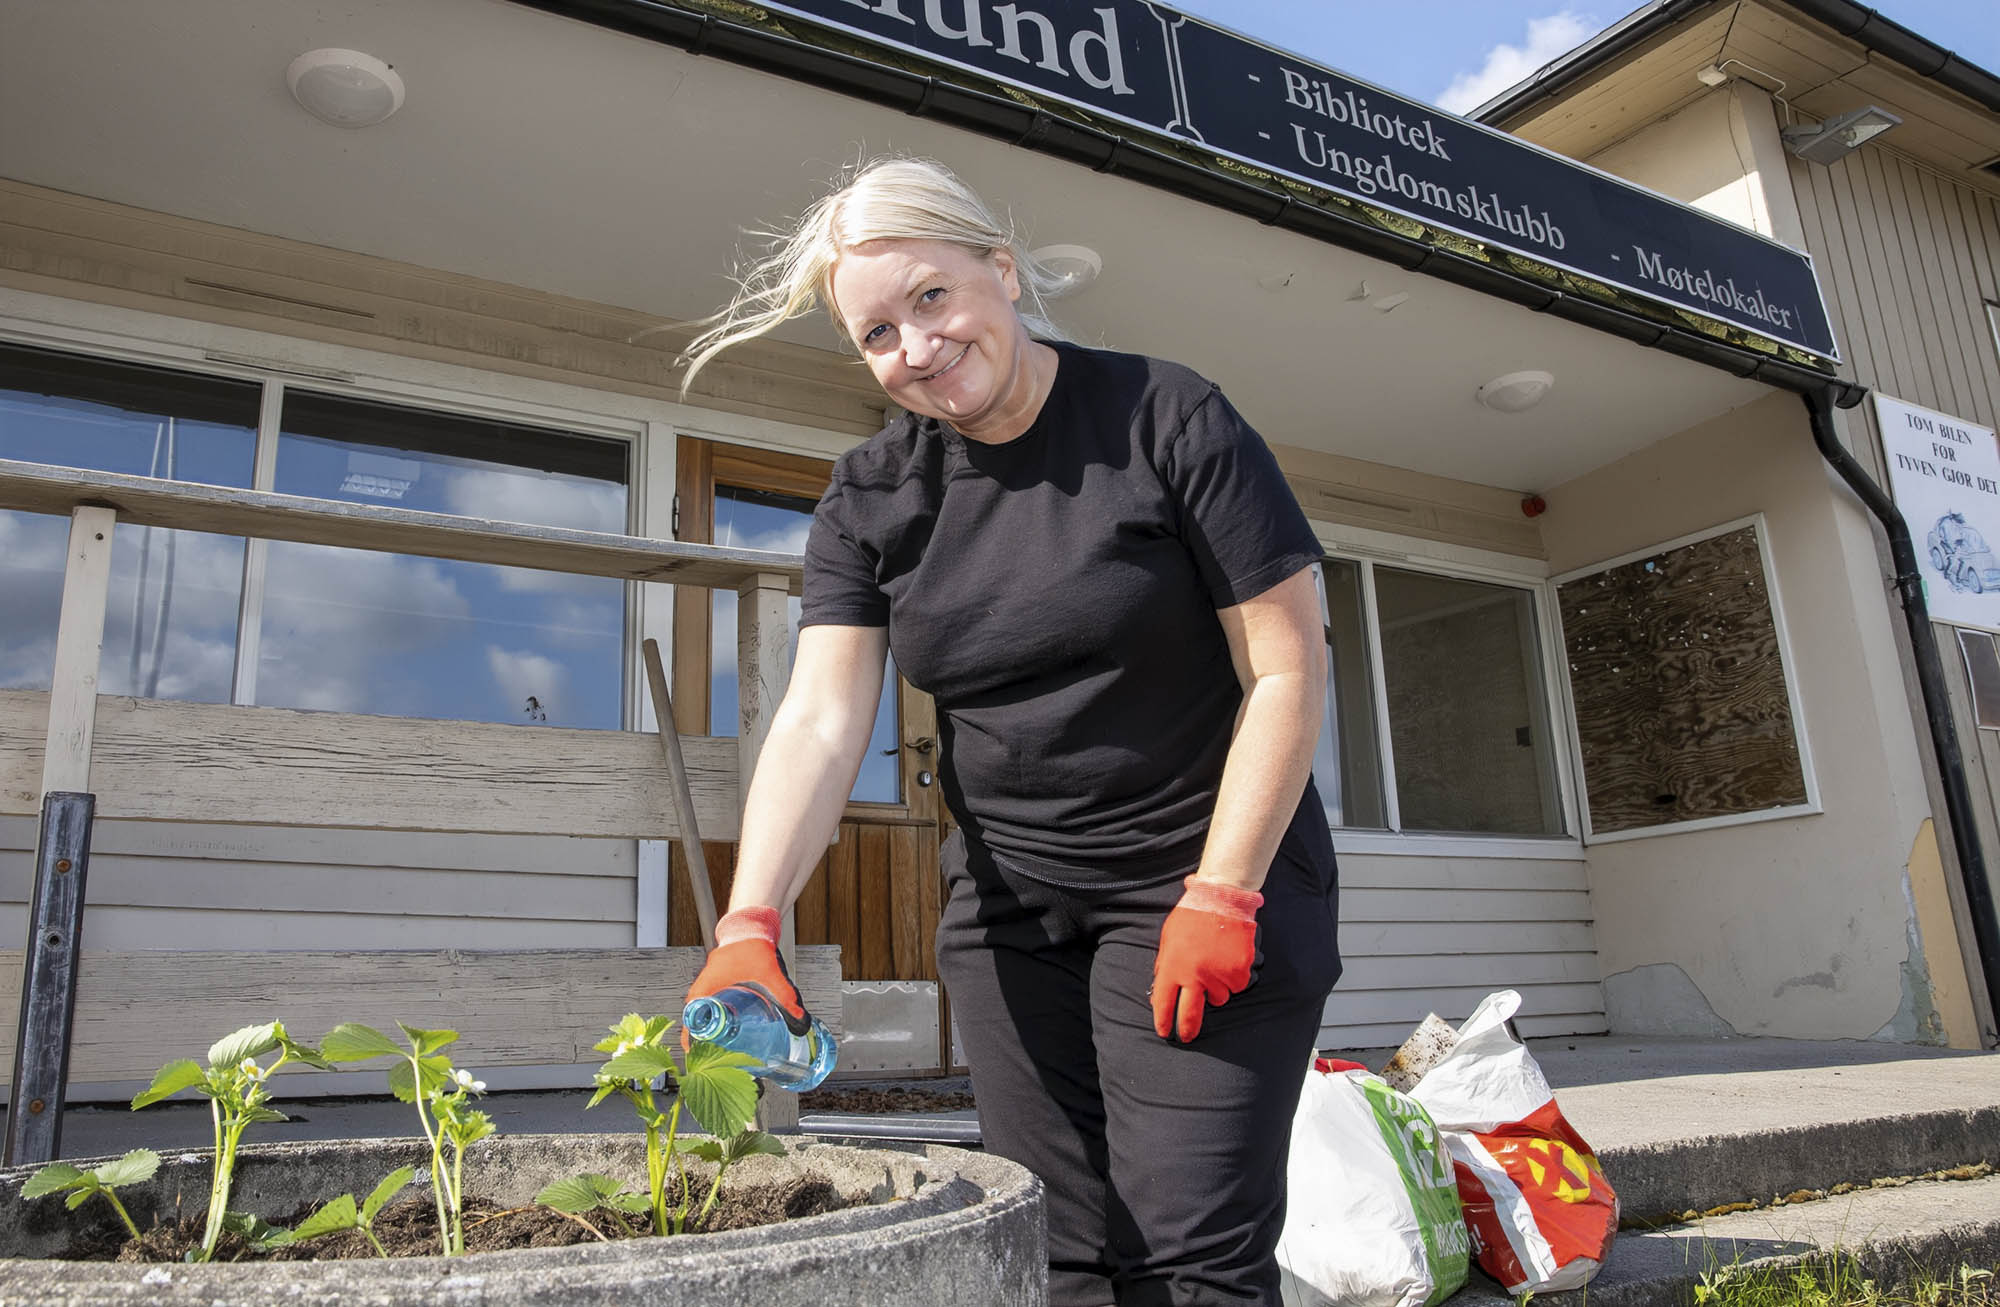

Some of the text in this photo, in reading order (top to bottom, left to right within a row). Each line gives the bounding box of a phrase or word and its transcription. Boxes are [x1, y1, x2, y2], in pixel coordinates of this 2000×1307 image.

[840, 0, 1136, 95] und
[1280, 67, 1452, 162] Bibliotek
[1289, 123, 1566, 249] Ungdomsklubb
[1632, 245, 1793, 329] Møtelokaler
[1904, 412, 1973, 445] TØM BILEN
[1931, 442, 1957, 462] FØR
[1895, 453, 1998, 495] TYVEN GJØR DET
